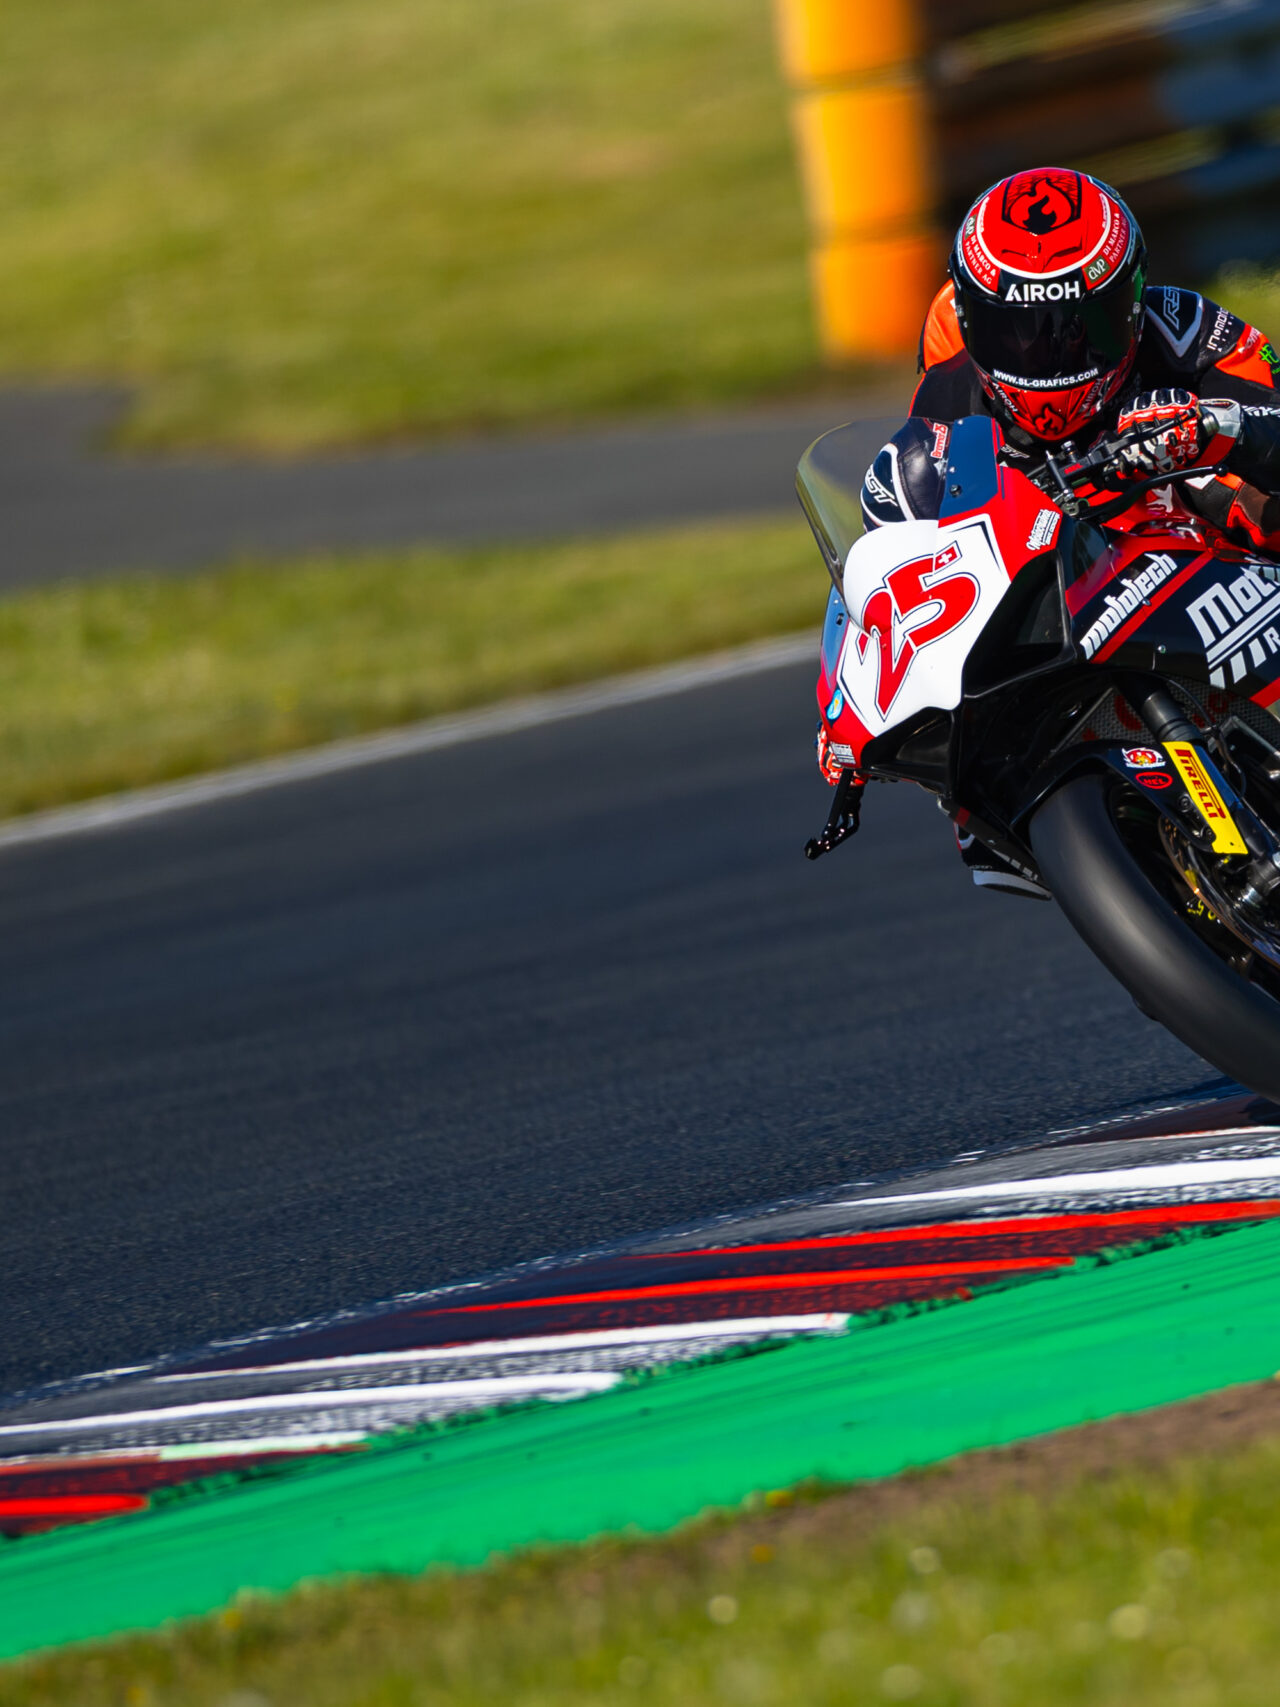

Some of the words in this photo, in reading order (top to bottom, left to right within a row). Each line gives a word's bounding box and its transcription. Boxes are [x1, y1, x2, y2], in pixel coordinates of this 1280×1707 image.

[1108, 219, 1120, 247] MARCO
[965, 241, 983, 275] PARTNER
[973, 244, 991, 271] MARCO
[1005, 280, 1082, 303] AIROH
[993, 368, 1099, 388] WWW.SL-GRAFICS.COM
[992, 382, 1019, 413] AIROH
[1079, 553, 1179, 660] mototech
[856, 541, 982, 720] 25
[1174, 749, 1226, 819] PIRELLI
